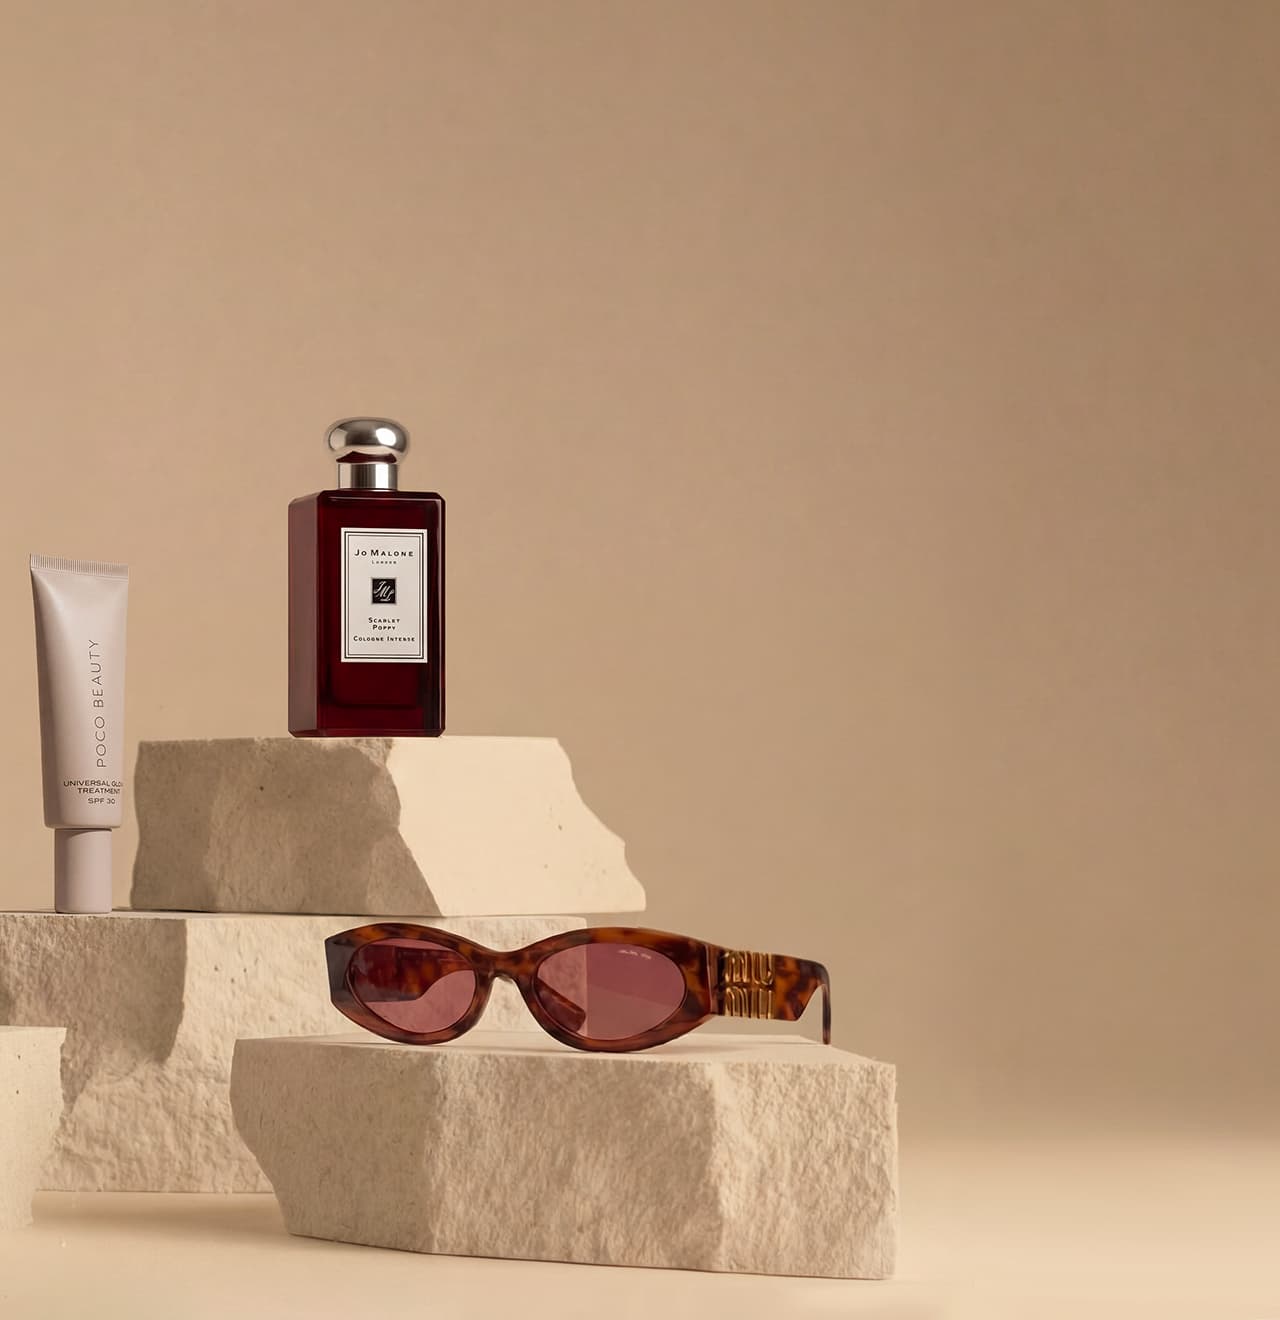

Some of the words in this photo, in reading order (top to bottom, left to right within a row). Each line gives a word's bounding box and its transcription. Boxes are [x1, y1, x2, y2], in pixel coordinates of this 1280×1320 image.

[370, 549, 414, 557] MALONE
[88, 639, 105, 708] BEAUTY
[94, 715, 108, 768] POCO
[63, 780, 111, 788] UNIVERSAL
[77, 787, 121, 795] TREATMENT
